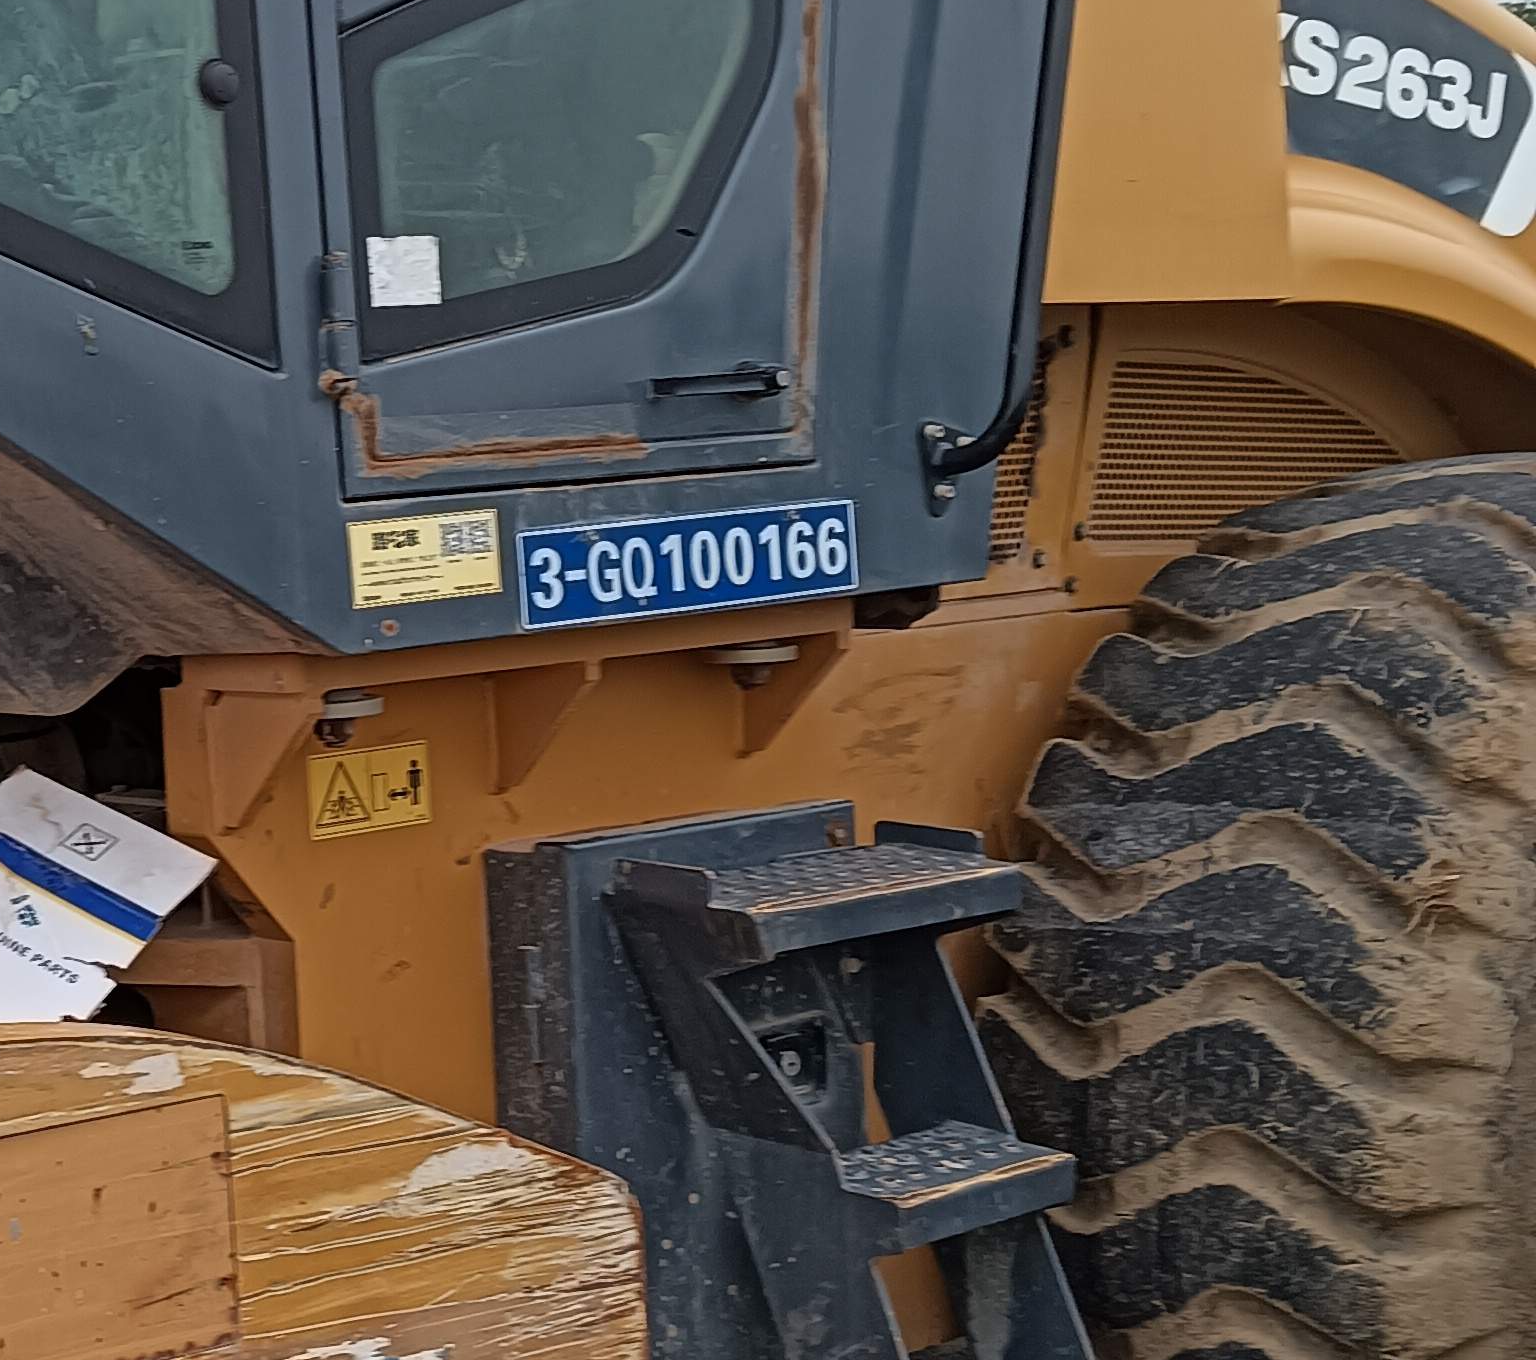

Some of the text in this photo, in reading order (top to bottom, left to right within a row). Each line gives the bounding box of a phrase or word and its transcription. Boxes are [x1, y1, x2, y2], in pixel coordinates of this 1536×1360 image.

[1278, 13, 1508, 139] S263J
[529, 517, 849, 610] 3-GQ100166
[29, 953, 80, 984] PARTS
